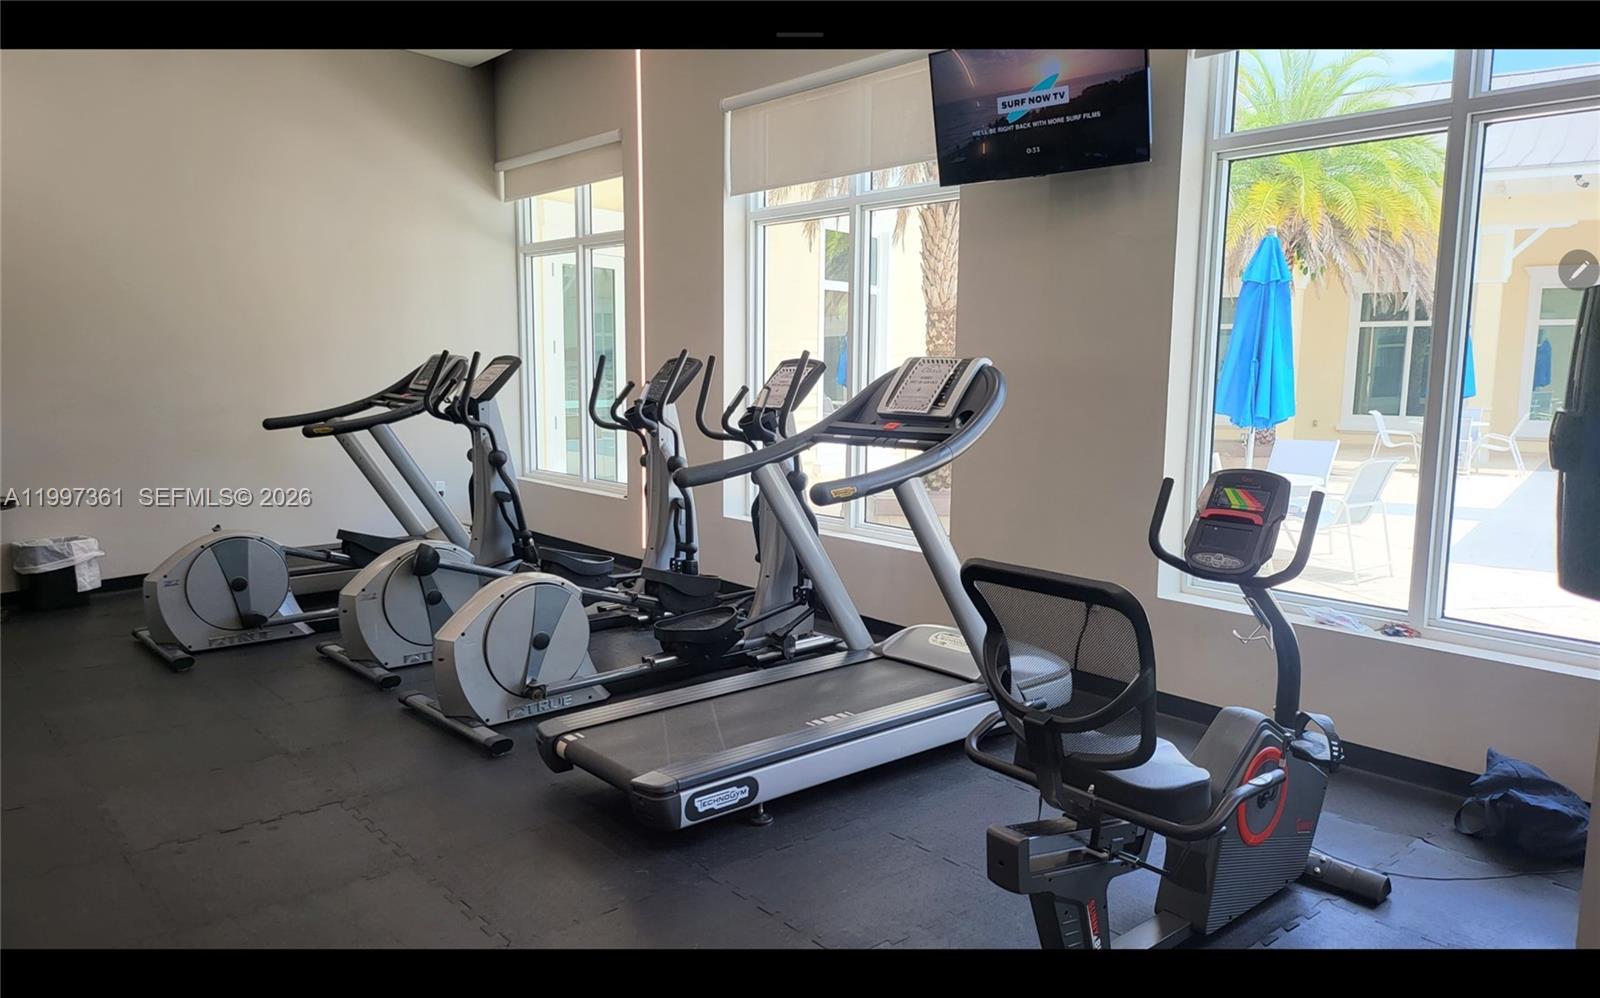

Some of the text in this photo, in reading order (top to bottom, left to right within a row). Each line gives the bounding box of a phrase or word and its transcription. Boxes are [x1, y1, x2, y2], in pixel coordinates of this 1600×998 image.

[1001, 91, 1065, 109] SURF NOW TV
[972, 129, 988, 137] WE'LL
[997, 124, 1014, 133] RIGHT
[1015, 122, 1032, 130] BACK
[1032, 119, 1047, 128] WITH
[1047, 116, 1065, 125] MORE
[1066, 114, 1081, 122] SURF
[1082, 111, 1101, 120] FILMS
[524, 694, 573, 715] TRUE
